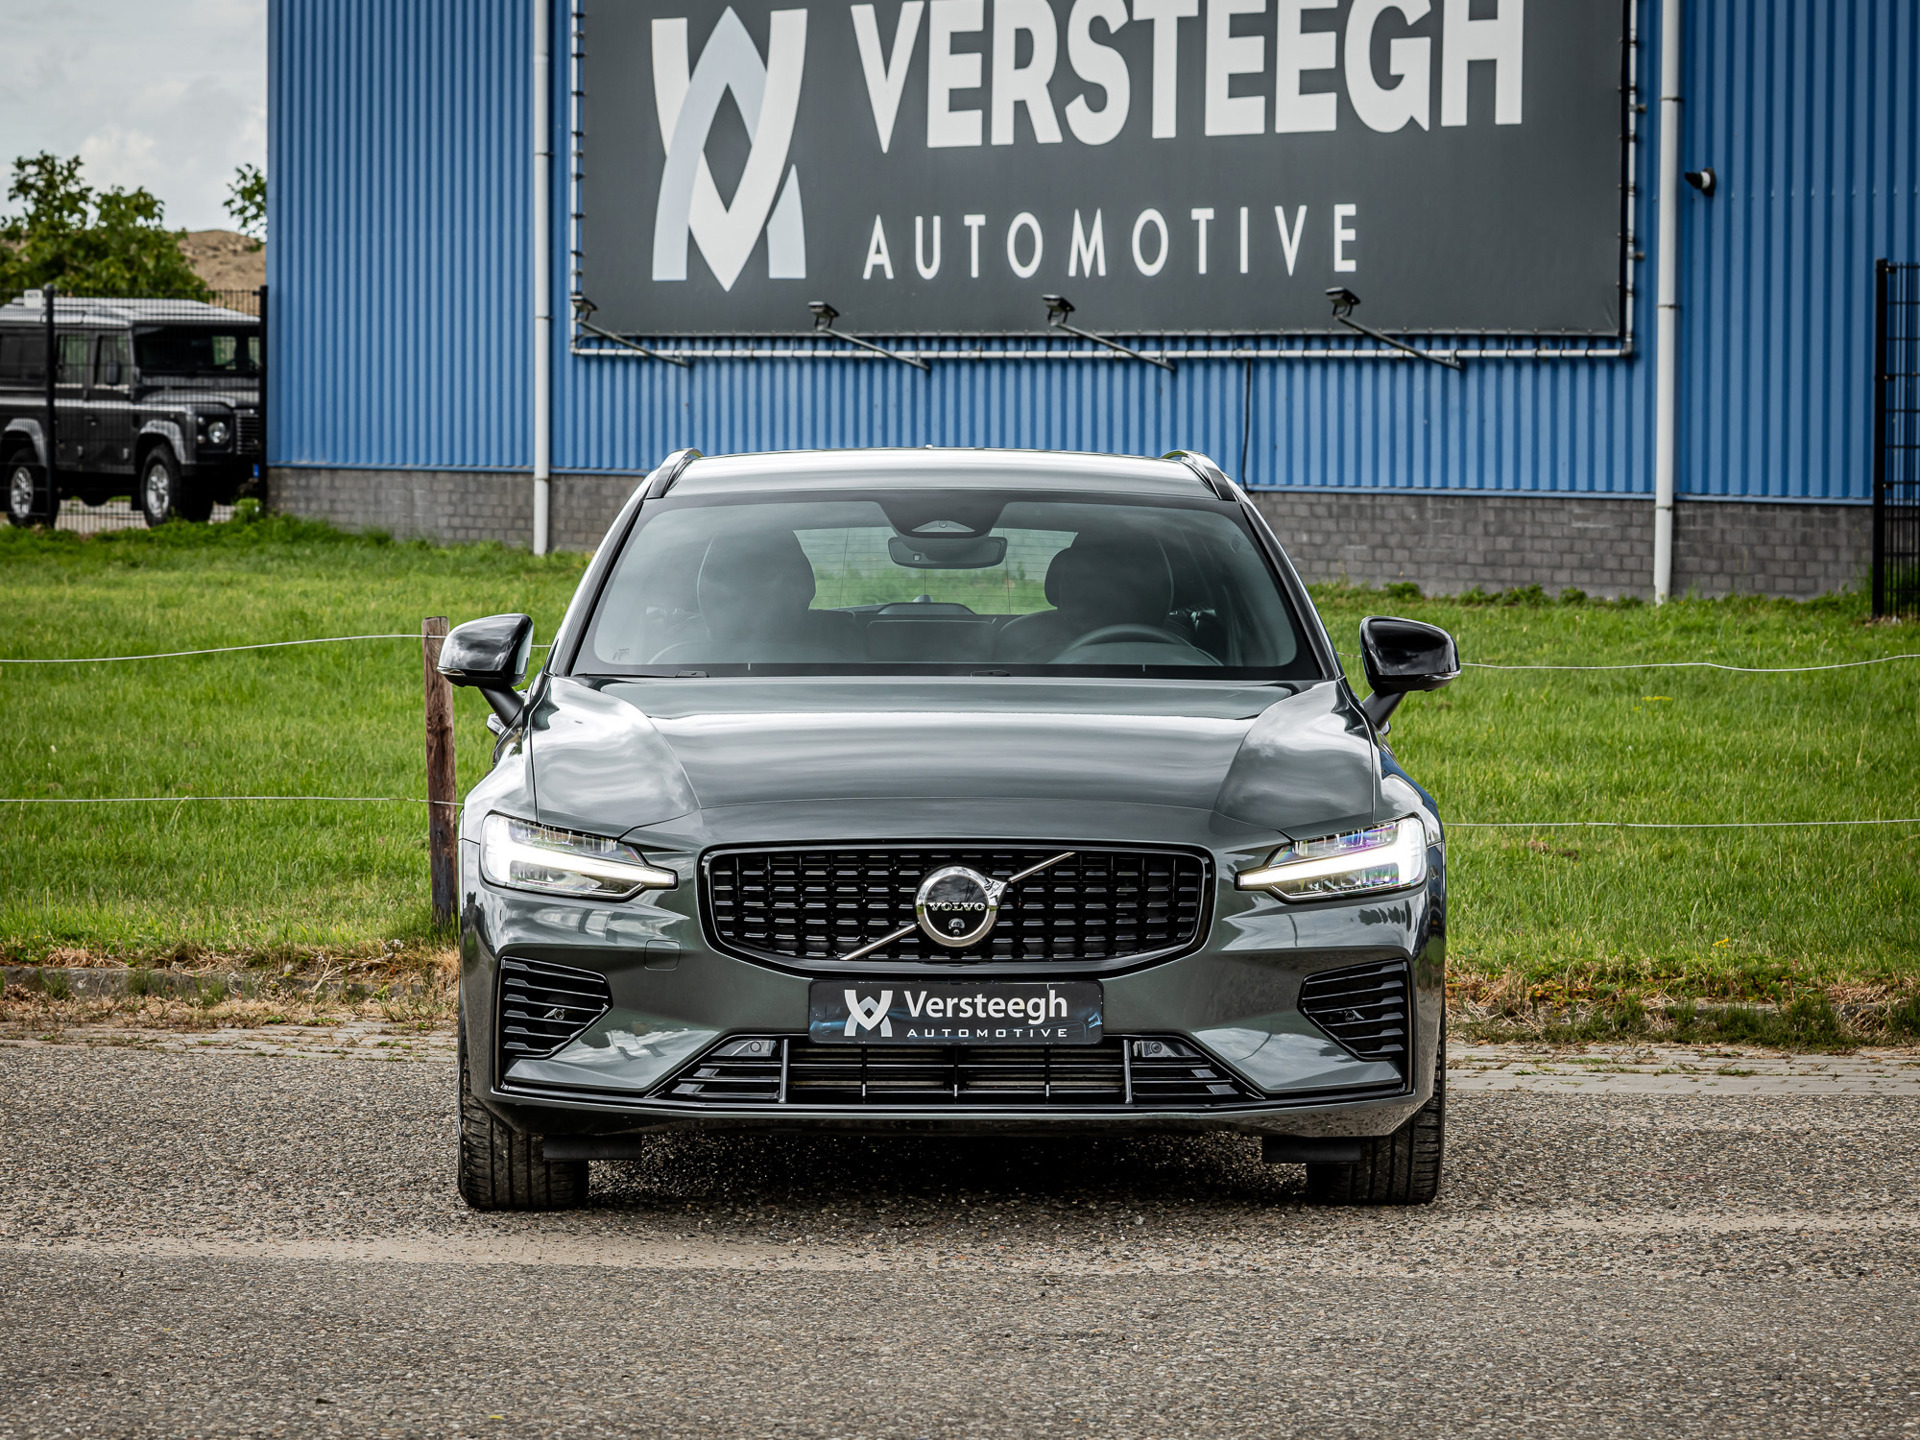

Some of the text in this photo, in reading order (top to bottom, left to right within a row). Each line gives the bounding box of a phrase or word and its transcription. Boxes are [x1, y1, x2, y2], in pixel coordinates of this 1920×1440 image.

[851, 0, 1524, 154] VERSTEEGH
[863, 203, 1357, 280] AUTOMOTIVE
[927, 902, 986, 911] VOLVO
[904, 989, 1068, 1024] Versteegh
[906, 1028, 1068, 1038] AUTOMOTIVE
